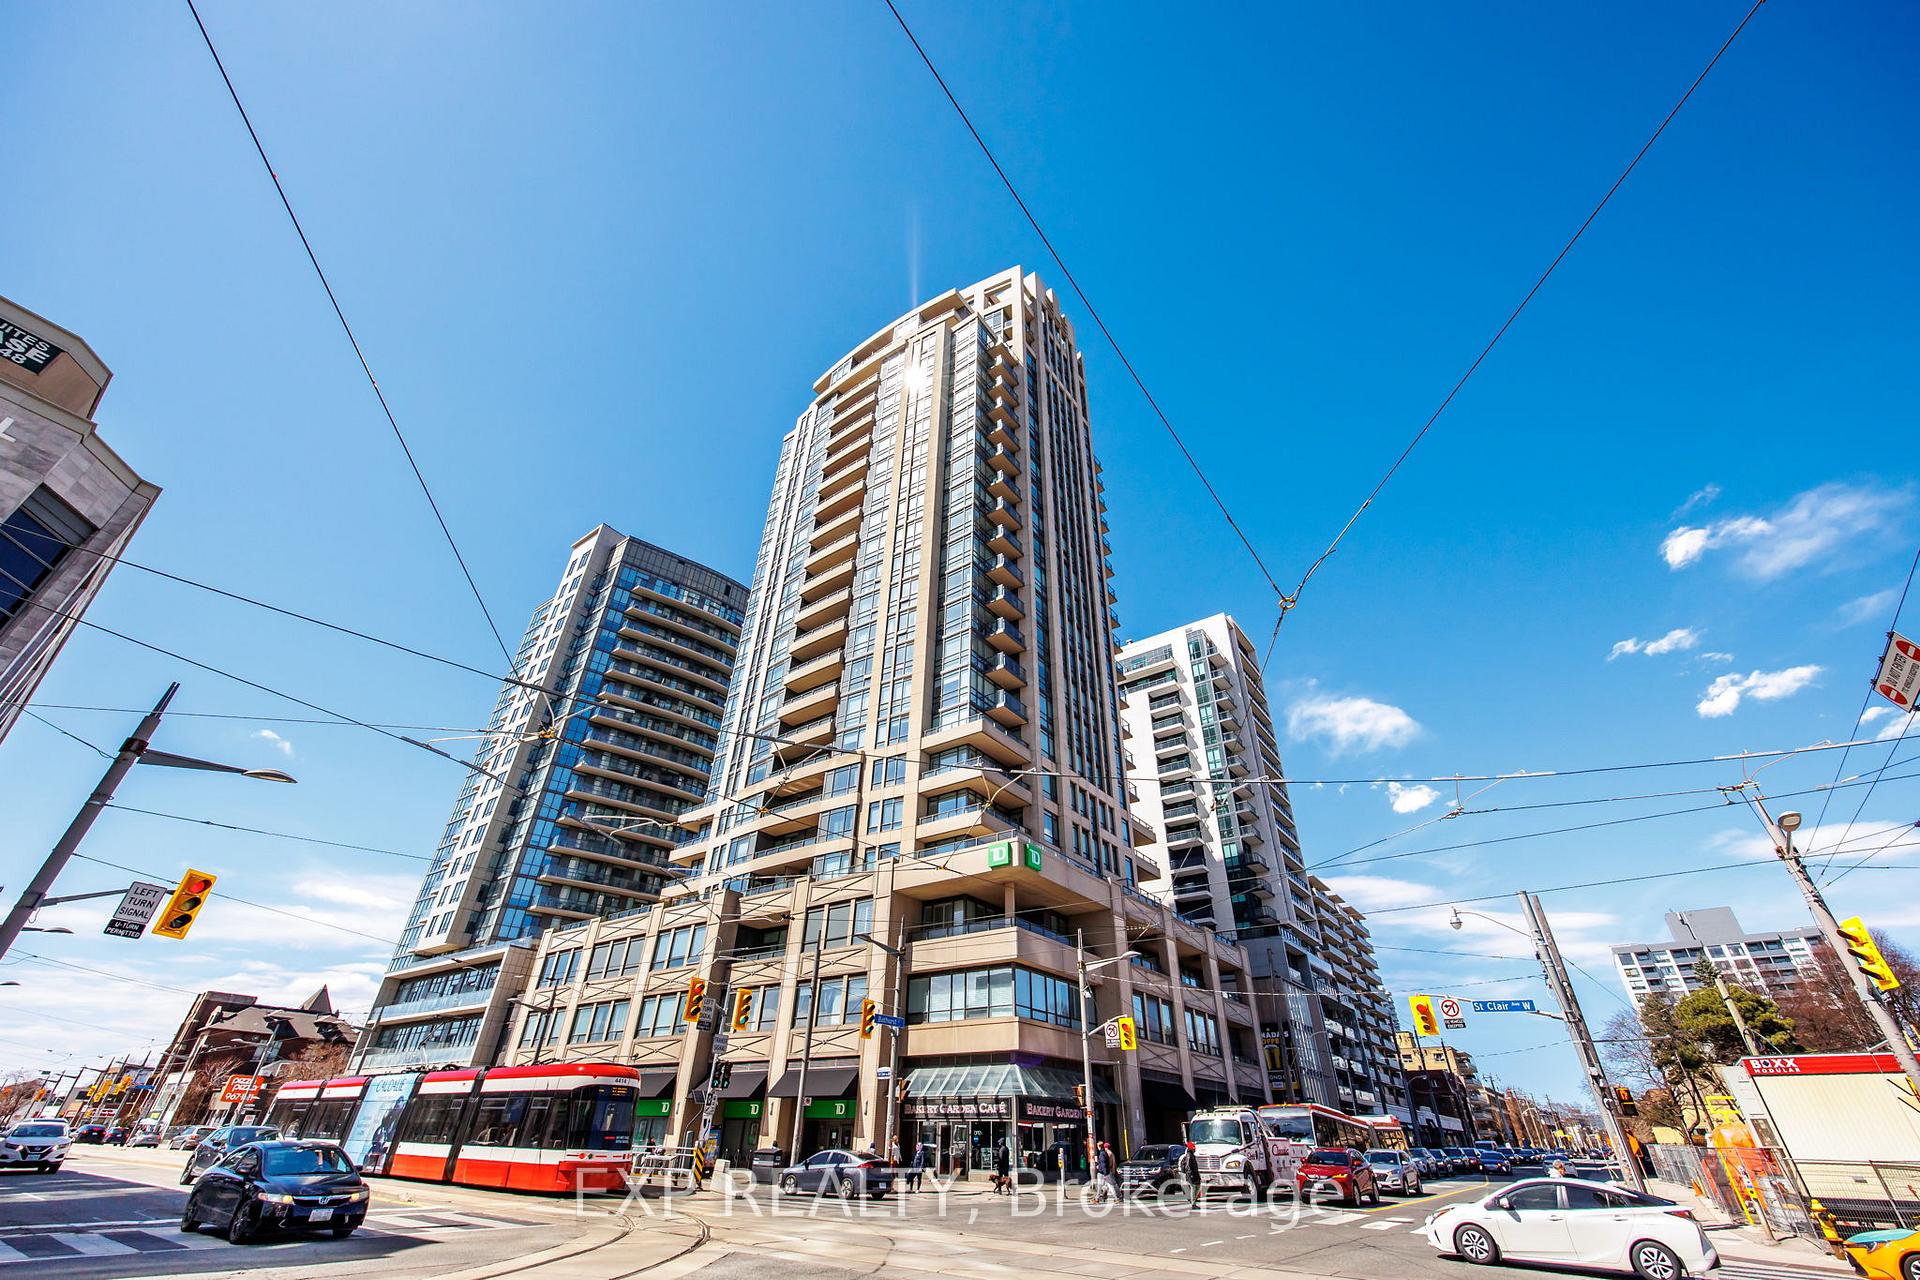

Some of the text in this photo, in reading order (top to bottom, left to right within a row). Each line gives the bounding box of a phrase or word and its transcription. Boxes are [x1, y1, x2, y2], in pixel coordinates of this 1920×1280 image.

[1891, 653, 1908, 670] ENTER
[990, 846, 1007, 862] TD
[1029, 848, 1040, 865] TD
[134, 887, 159, 898] LEFT
[128, 897, 155, 909] TURN
[119, 907, 149, 919] SIGNAL
[114, 921, 140, 931] U-TURN
[106, 927, 140, 938] PERMITTED
[1474, 1002, 1485, 1011] St
[1487, 1001, 1509, 1011] Clair
[1522, 1002, 1531, 1010] W
[1749, 1058, 1799, 1069] BOXX
[661, 1102, 670, 1113] TD
[750, 1103, 759, 1115] TD
[835, 1103, 845, 1115] TD
[904, 1103, 938, 1114] BAKERY
[940, 1103, 977, 1114] GARDEN
[1026, 1103, 1054, 1117] BAKERY
[1055, 1105, 1082, 1119] GARDEN
